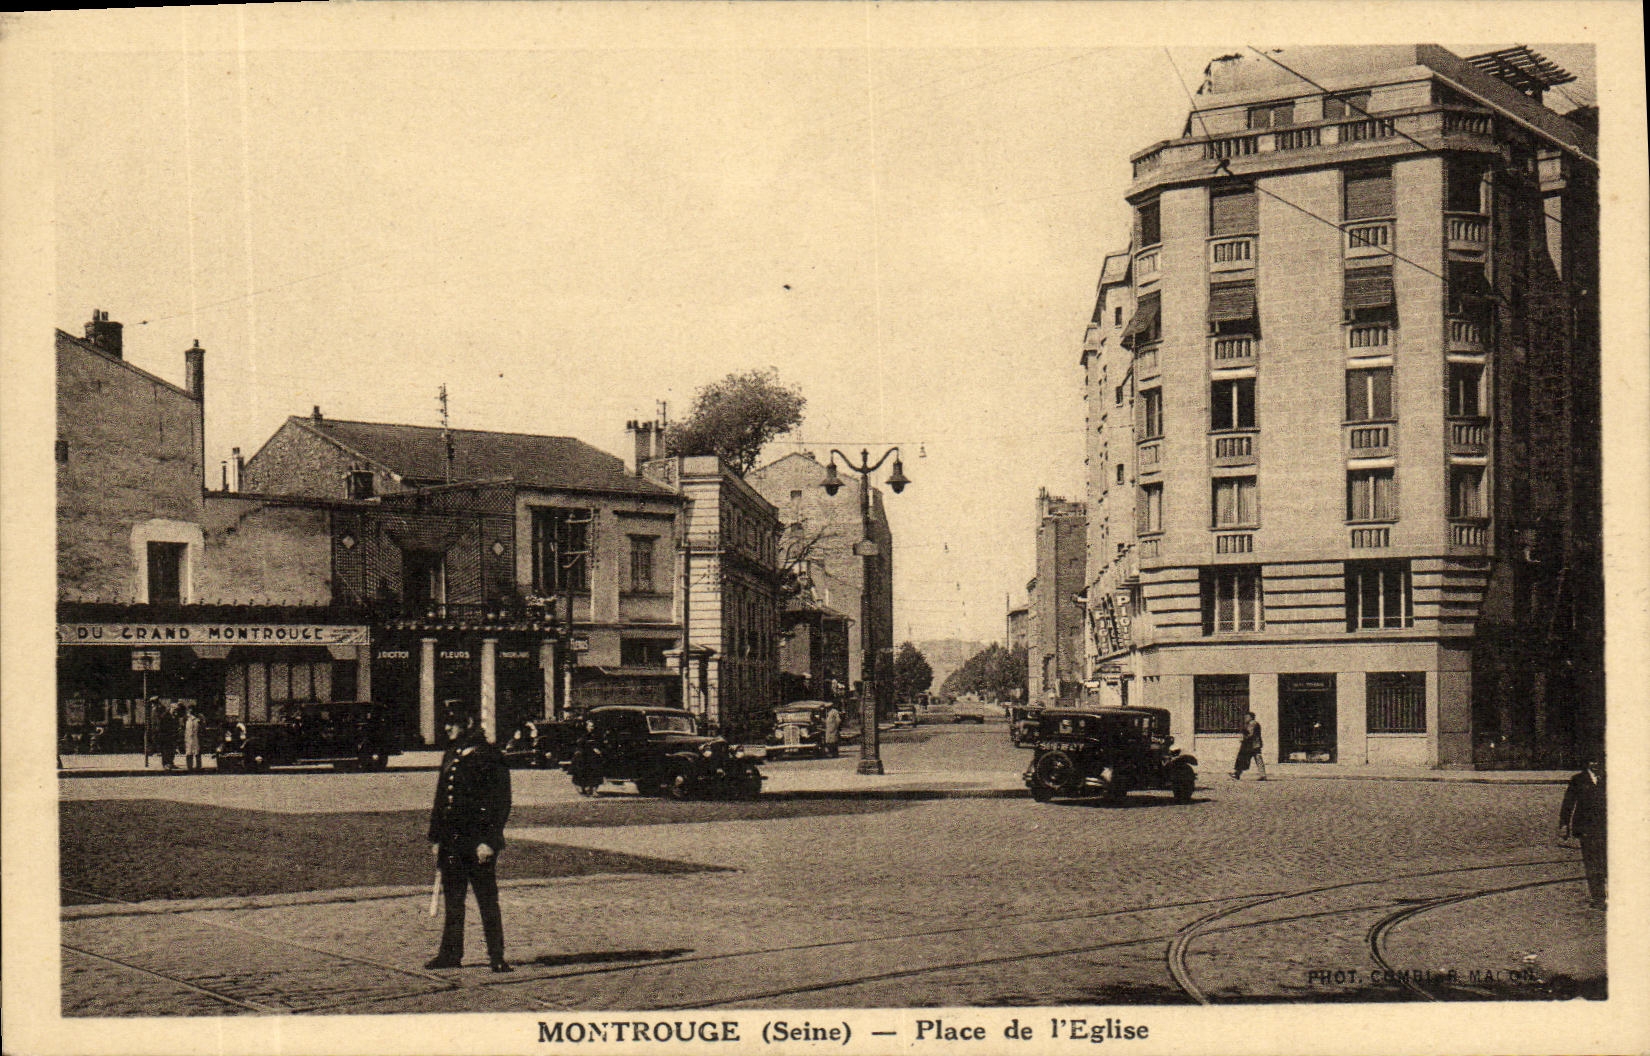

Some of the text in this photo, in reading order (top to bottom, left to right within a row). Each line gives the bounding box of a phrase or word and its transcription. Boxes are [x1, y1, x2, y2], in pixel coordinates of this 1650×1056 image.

[77, 626, 103, 640] DU
[121, 626, 191, 640] GRAND
[208, 626, 325, 641] MONTROUGE
[440, 650, 470, 660] FLEURS
